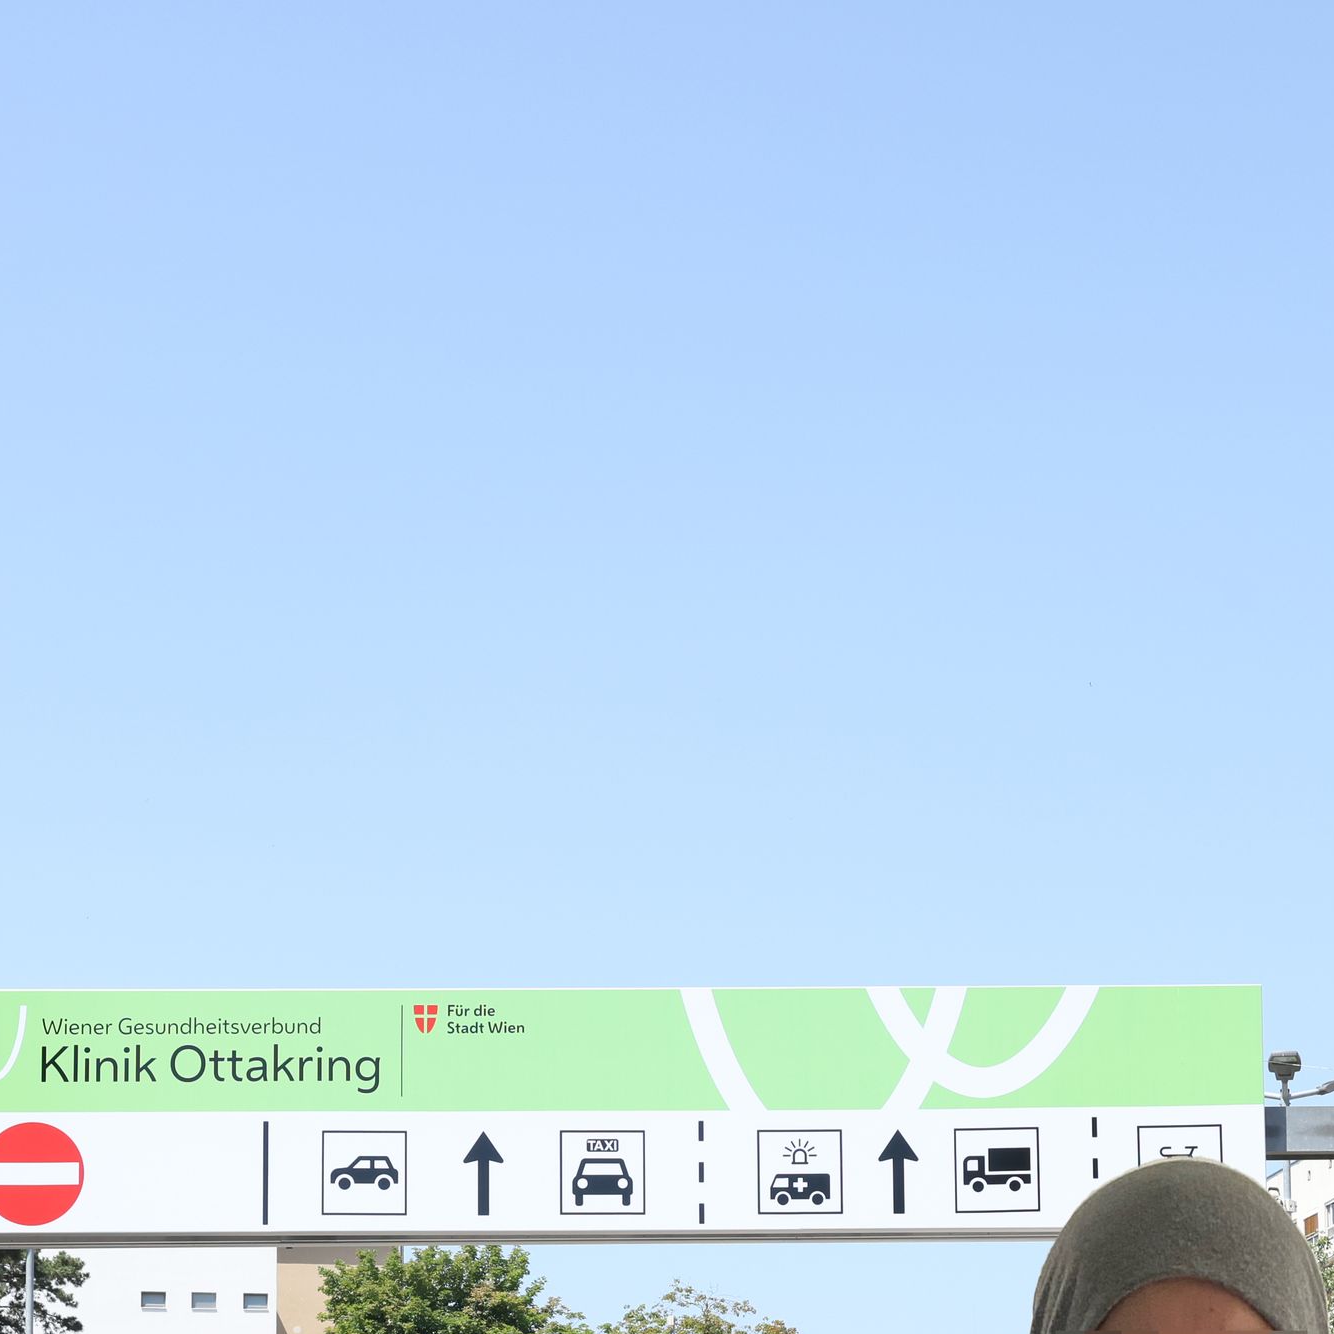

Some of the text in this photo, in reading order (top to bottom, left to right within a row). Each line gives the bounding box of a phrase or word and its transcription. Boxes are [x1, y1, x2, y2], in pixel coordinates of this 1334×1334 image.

[447, 1004, 496, 1017] Für die
[42, 1016, 321, 1035] Wiener Gesundheitsverbund
[447, 1021, 525, 1034] Stadt Wien
[41, 1043, 381, 1094] Klinik Ottakring
[587, 1140, 618, 1151] TAXI
